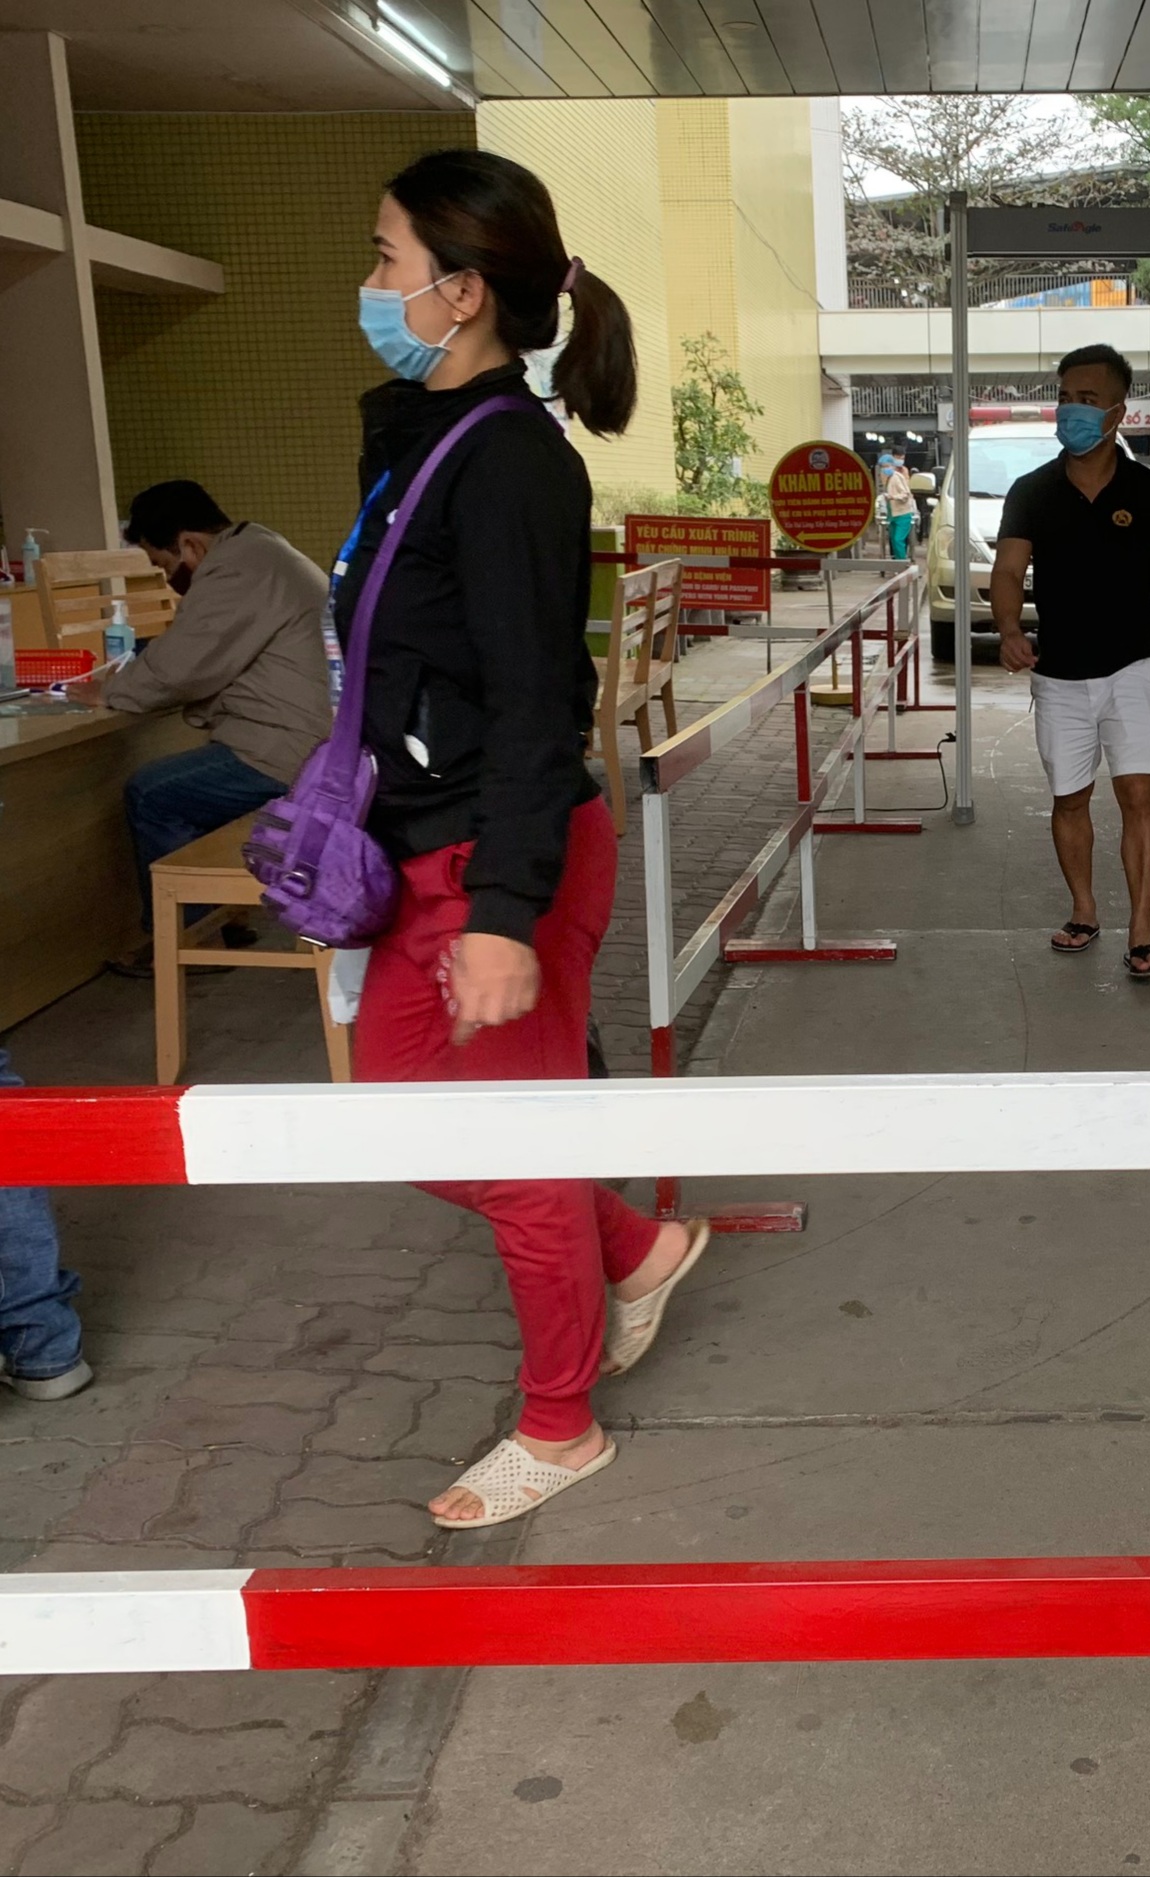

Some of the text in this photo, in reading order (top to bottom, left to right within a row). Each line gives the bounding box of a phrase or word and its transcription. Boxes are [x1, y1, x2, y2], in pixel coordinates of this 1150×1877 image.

[778, 468, 863, 496] KHÁM BỆNH
[636, 524, 658, 539] YÊU
[688, 525, 718, 541] XUẤT
[721, 528, 759, 543] TRÌNH:
